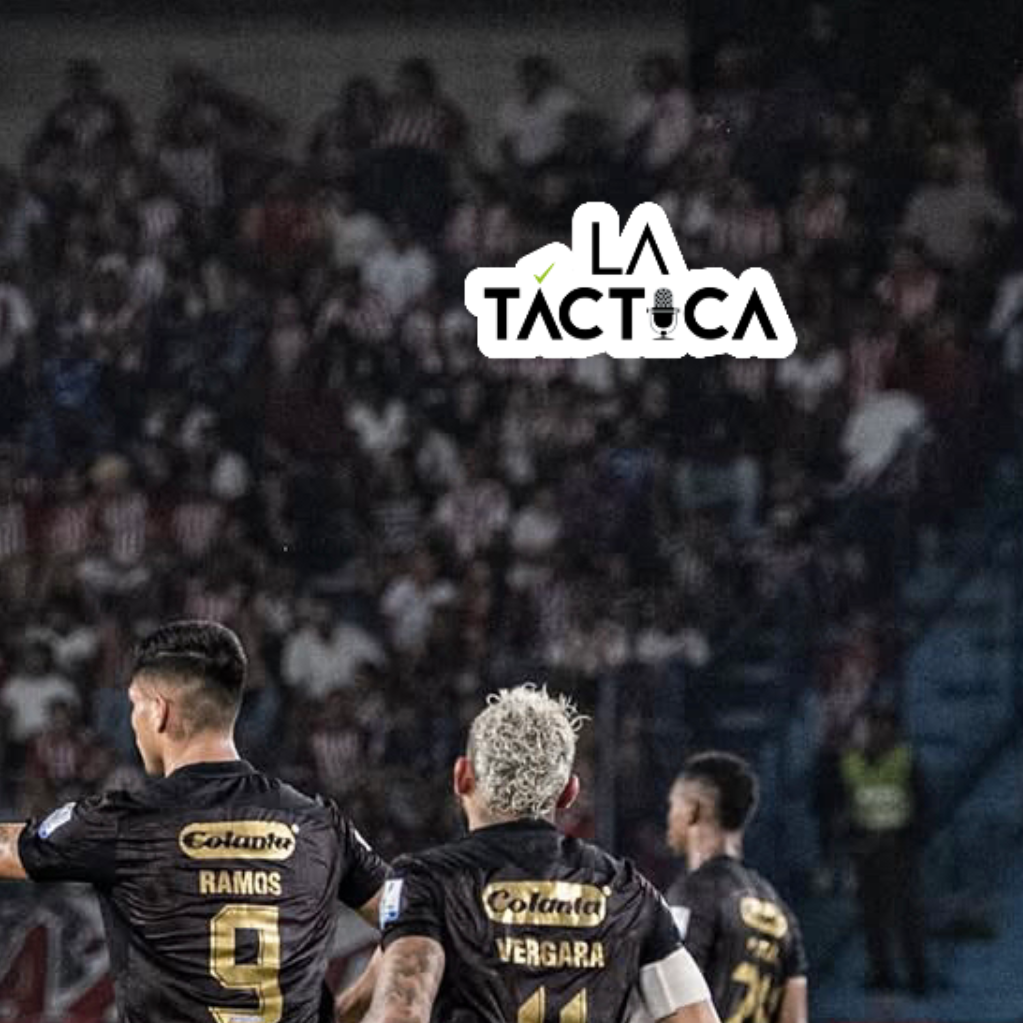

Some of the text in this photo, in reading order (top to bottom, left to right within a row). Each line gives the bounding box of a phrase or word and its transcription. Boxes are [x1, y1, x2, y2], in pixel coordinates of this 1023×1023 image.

[183, 830, 293, 851] Colanta
[199, 869, 283, 896] RAMOS
[487, 889, 602, 916] Colanta
[495, 936, 606, 968] VERGARA
